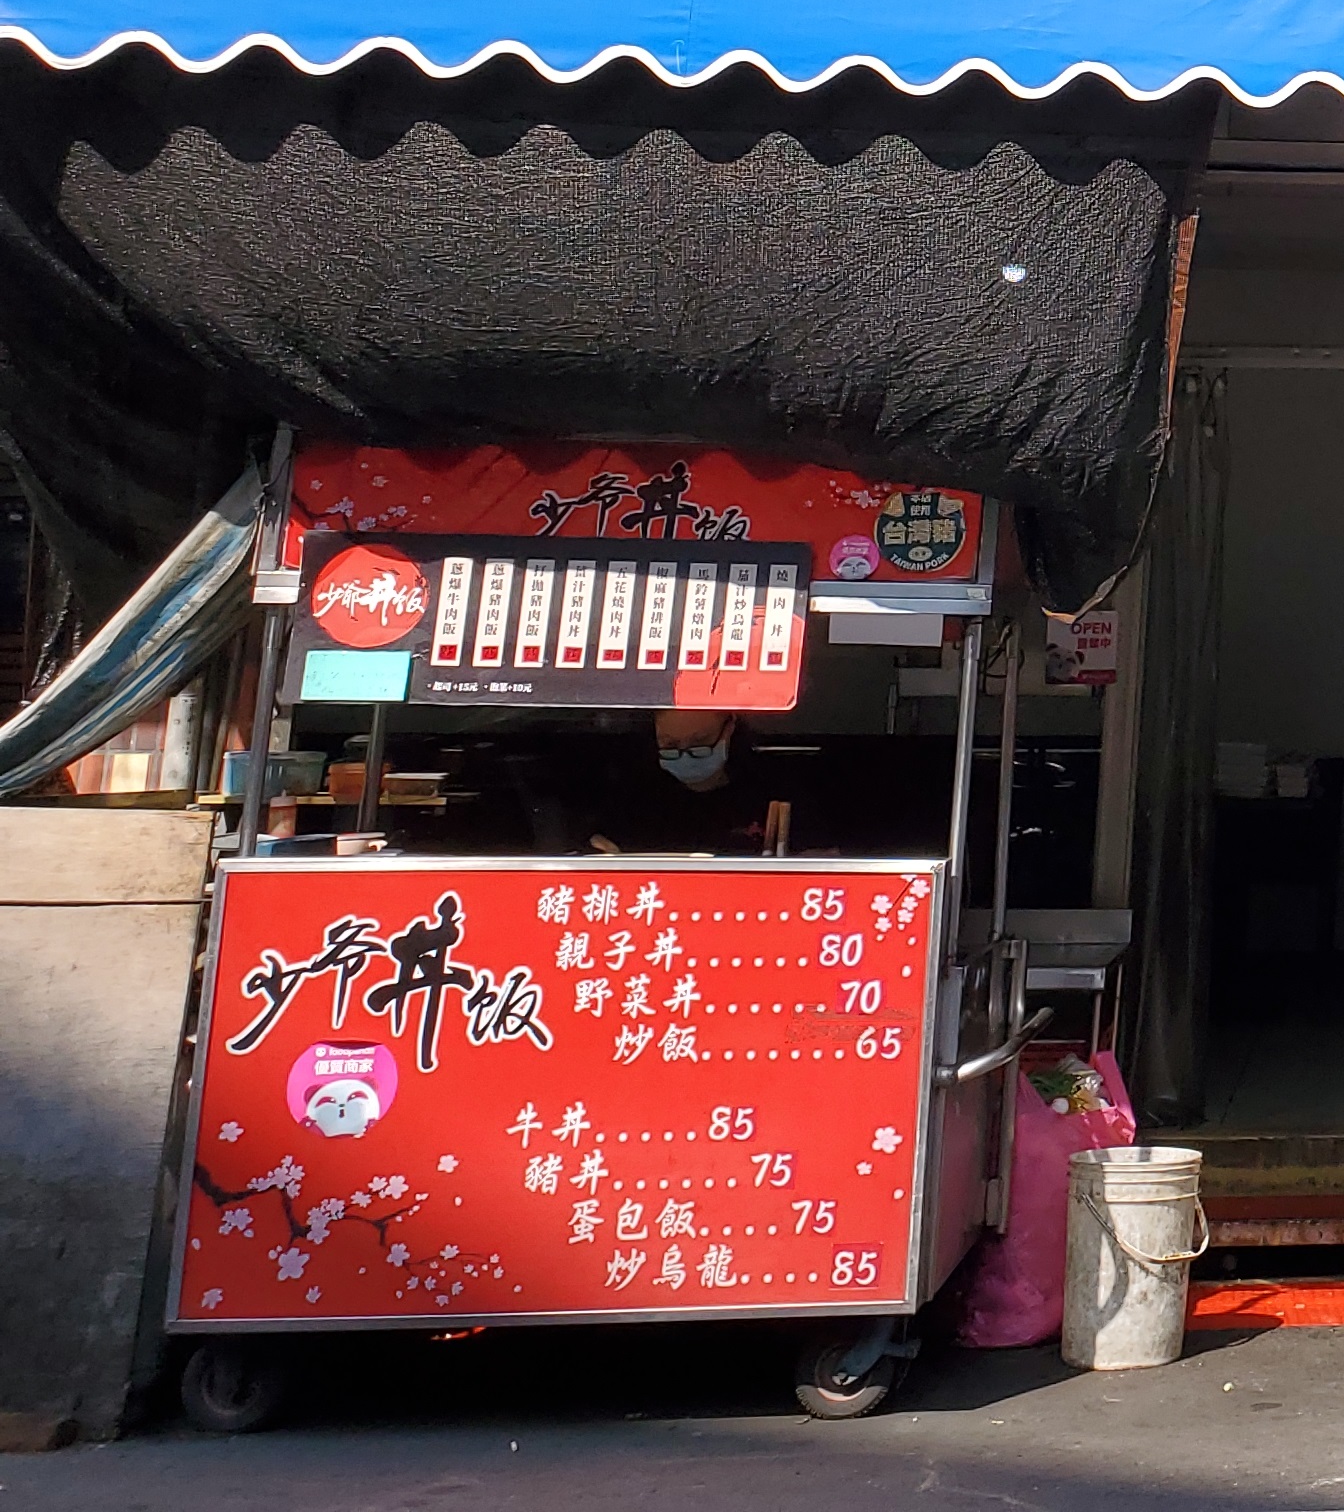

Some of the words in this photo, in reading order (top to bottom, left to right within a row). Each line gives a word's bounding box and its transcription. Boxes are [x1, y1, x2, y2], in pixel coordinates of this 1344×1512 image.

[889, 553, 924, 571] TAIWAN
[925, 552, 950, 571] PORK
[1071, 621, 1112, 635] OPEN
[537, 881, 666, 926] 豬排丼
[800, 888, 845, 921] 85
[555, 927, 684, 972] 親子丼
[818, 933, 864, 967] 80
[573, 974, 702, 1018] 野菜丼
[840, 979, 882, 1015] 70
[612, 1023, 699, 1066] 炒飯
[855, 1026, 902, 1060] 65
[505, 1101, 592, 1149] 牛丼
[708, 1105, 755, 1141] 85
[523, 1149, 609, 1196] 豬丼
[750, 1152, 793, 1188] 75
[567, 1197, 697, 1245] 蛋包飯
[791, 1199, 837, 1235] 75
[604, 1244, 739, 1292] 炒烏龍
[830, 1250, 879, 1286] 85
